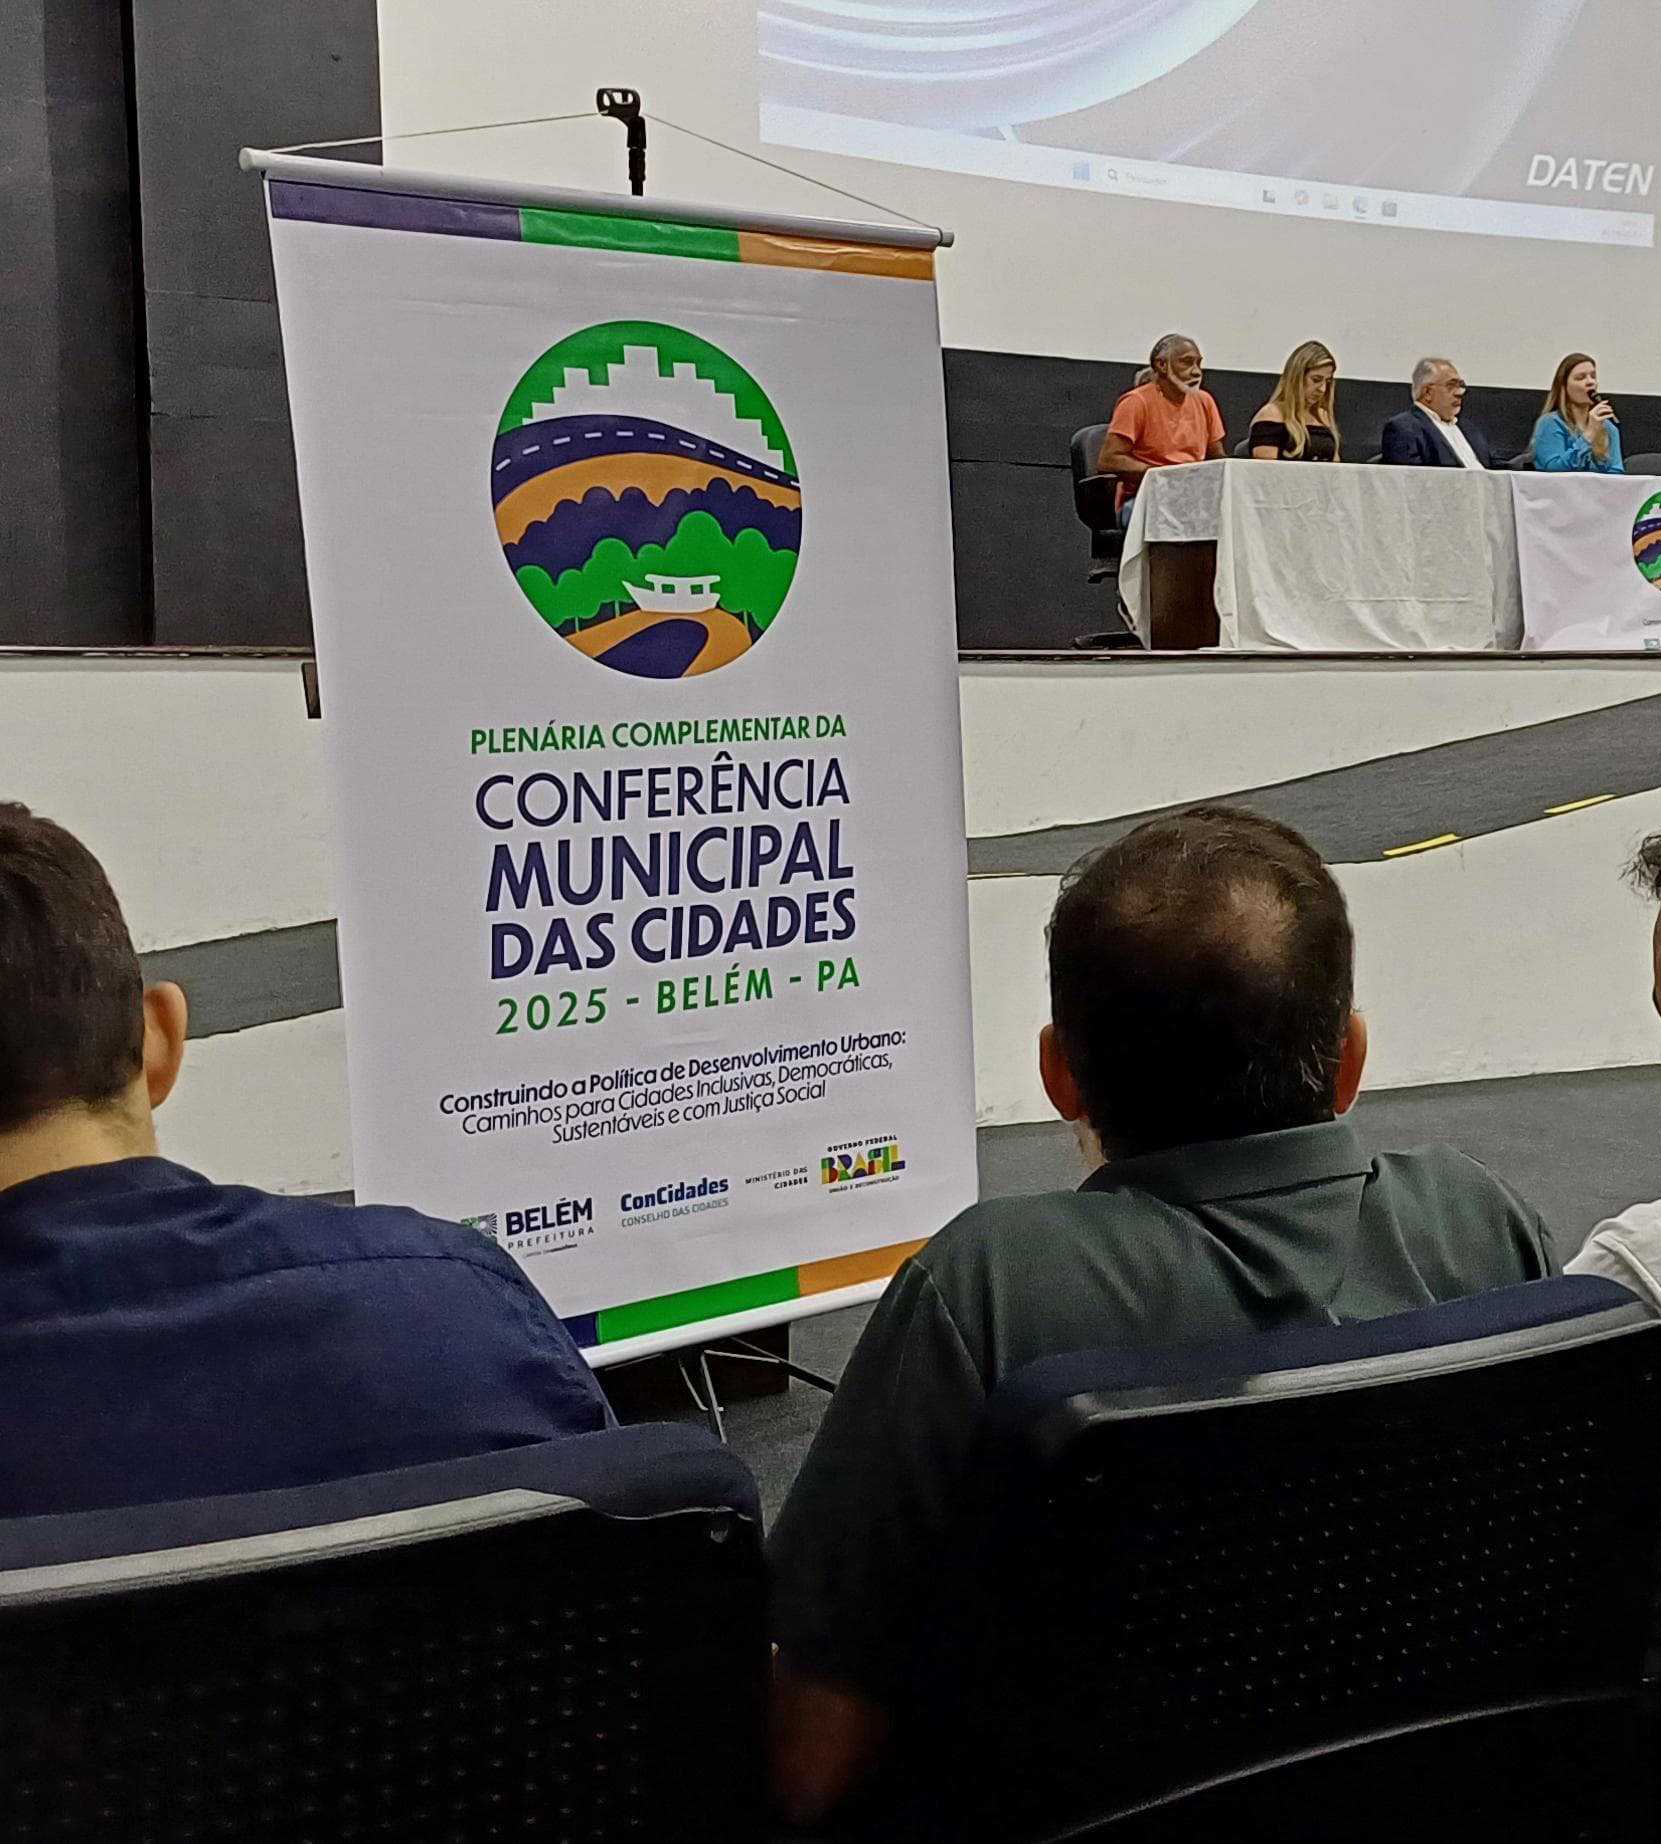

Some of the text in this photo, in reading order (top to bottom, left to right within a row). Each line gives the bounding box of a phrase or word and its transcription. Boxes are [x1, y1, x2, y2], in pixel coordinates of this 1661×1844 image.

[1526, 154, 1654, 196] DATEN
[471, 714, 846, 754] PLENÁRIA COMPLEMENTAR DA
[475, 751, 850, 830] CONFERÊNCIA
[485, 819, 854, 912] MUNICIPAL
[491, 889, 856, 979] DAS CIDADES
[496, 988, 607, 1035] 2025
[657, 965, 773, 1014] BELÉM
[817, 957, 860, 992] PA
[440, 1030, 907, 1114] Construindo a Política de Desenvolvimento Urbano:
[462, 1053, 893, 1135] Caminhos para Cidades Inclusivas, Democráticas,
[552, 1079, 826, 1144] Sustentáveis e com Justiça Social
[793, 1166, 808, 1175] DAS
[821, 1144, 905, 1184] BRASIL
[620, 1177, 729, 1212] ConCidades
[621, 1197, 729, 1228] CONSELHO DAS CIDADES
[505, 1197, 593, 1236] BELÉM
[508, 1227, 594, 1250] PREFEITURA
